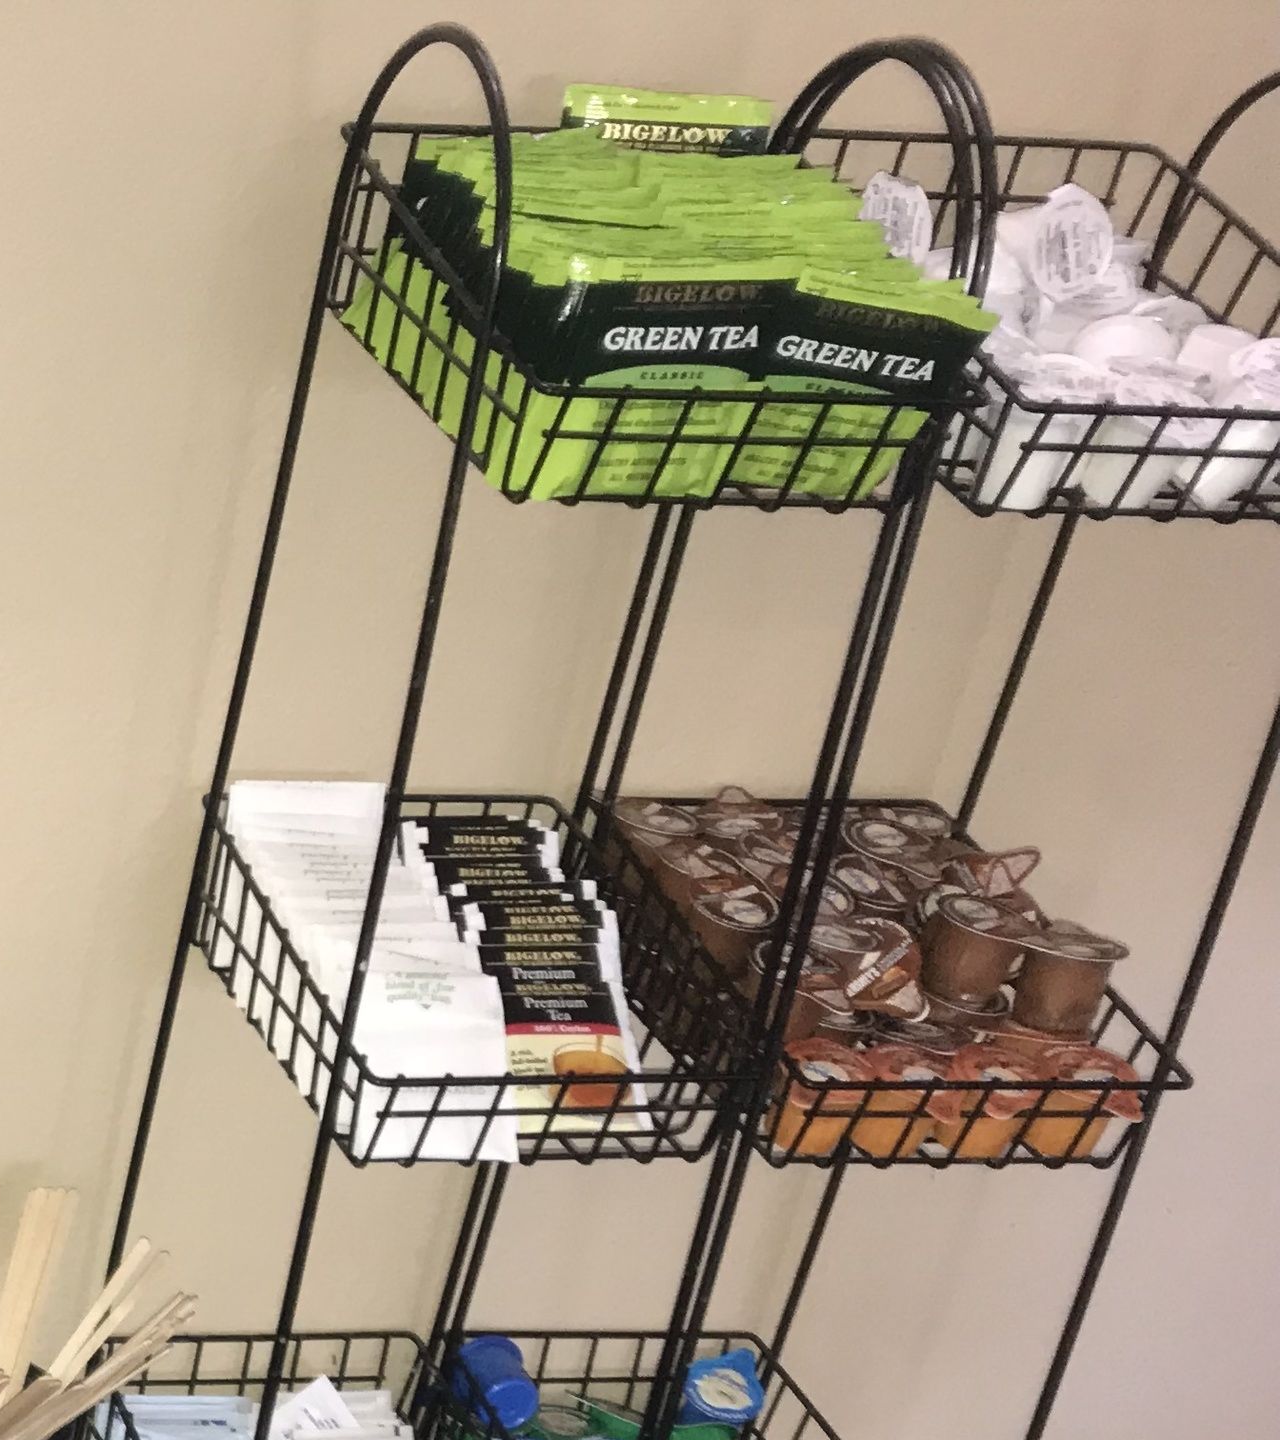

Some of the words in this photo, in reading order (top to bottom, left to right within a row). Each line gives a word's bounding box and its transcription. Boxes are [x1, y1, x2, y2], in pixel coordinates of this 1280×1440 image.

[601, 122, 733, 145] BIGELOW
[603, 326, 705, 351] GREEN
[707, 324, 759, 351] TEA
[776, 334, 880, 373] GREEN
[880, 353, 936, 382] TEA
[639, 370, 705, 381] CLASSIC
[511, 966, 576, 980] Premium
[522, 995, 589, 1008] Premium
[546, 1008, 572, 1021] Tea
